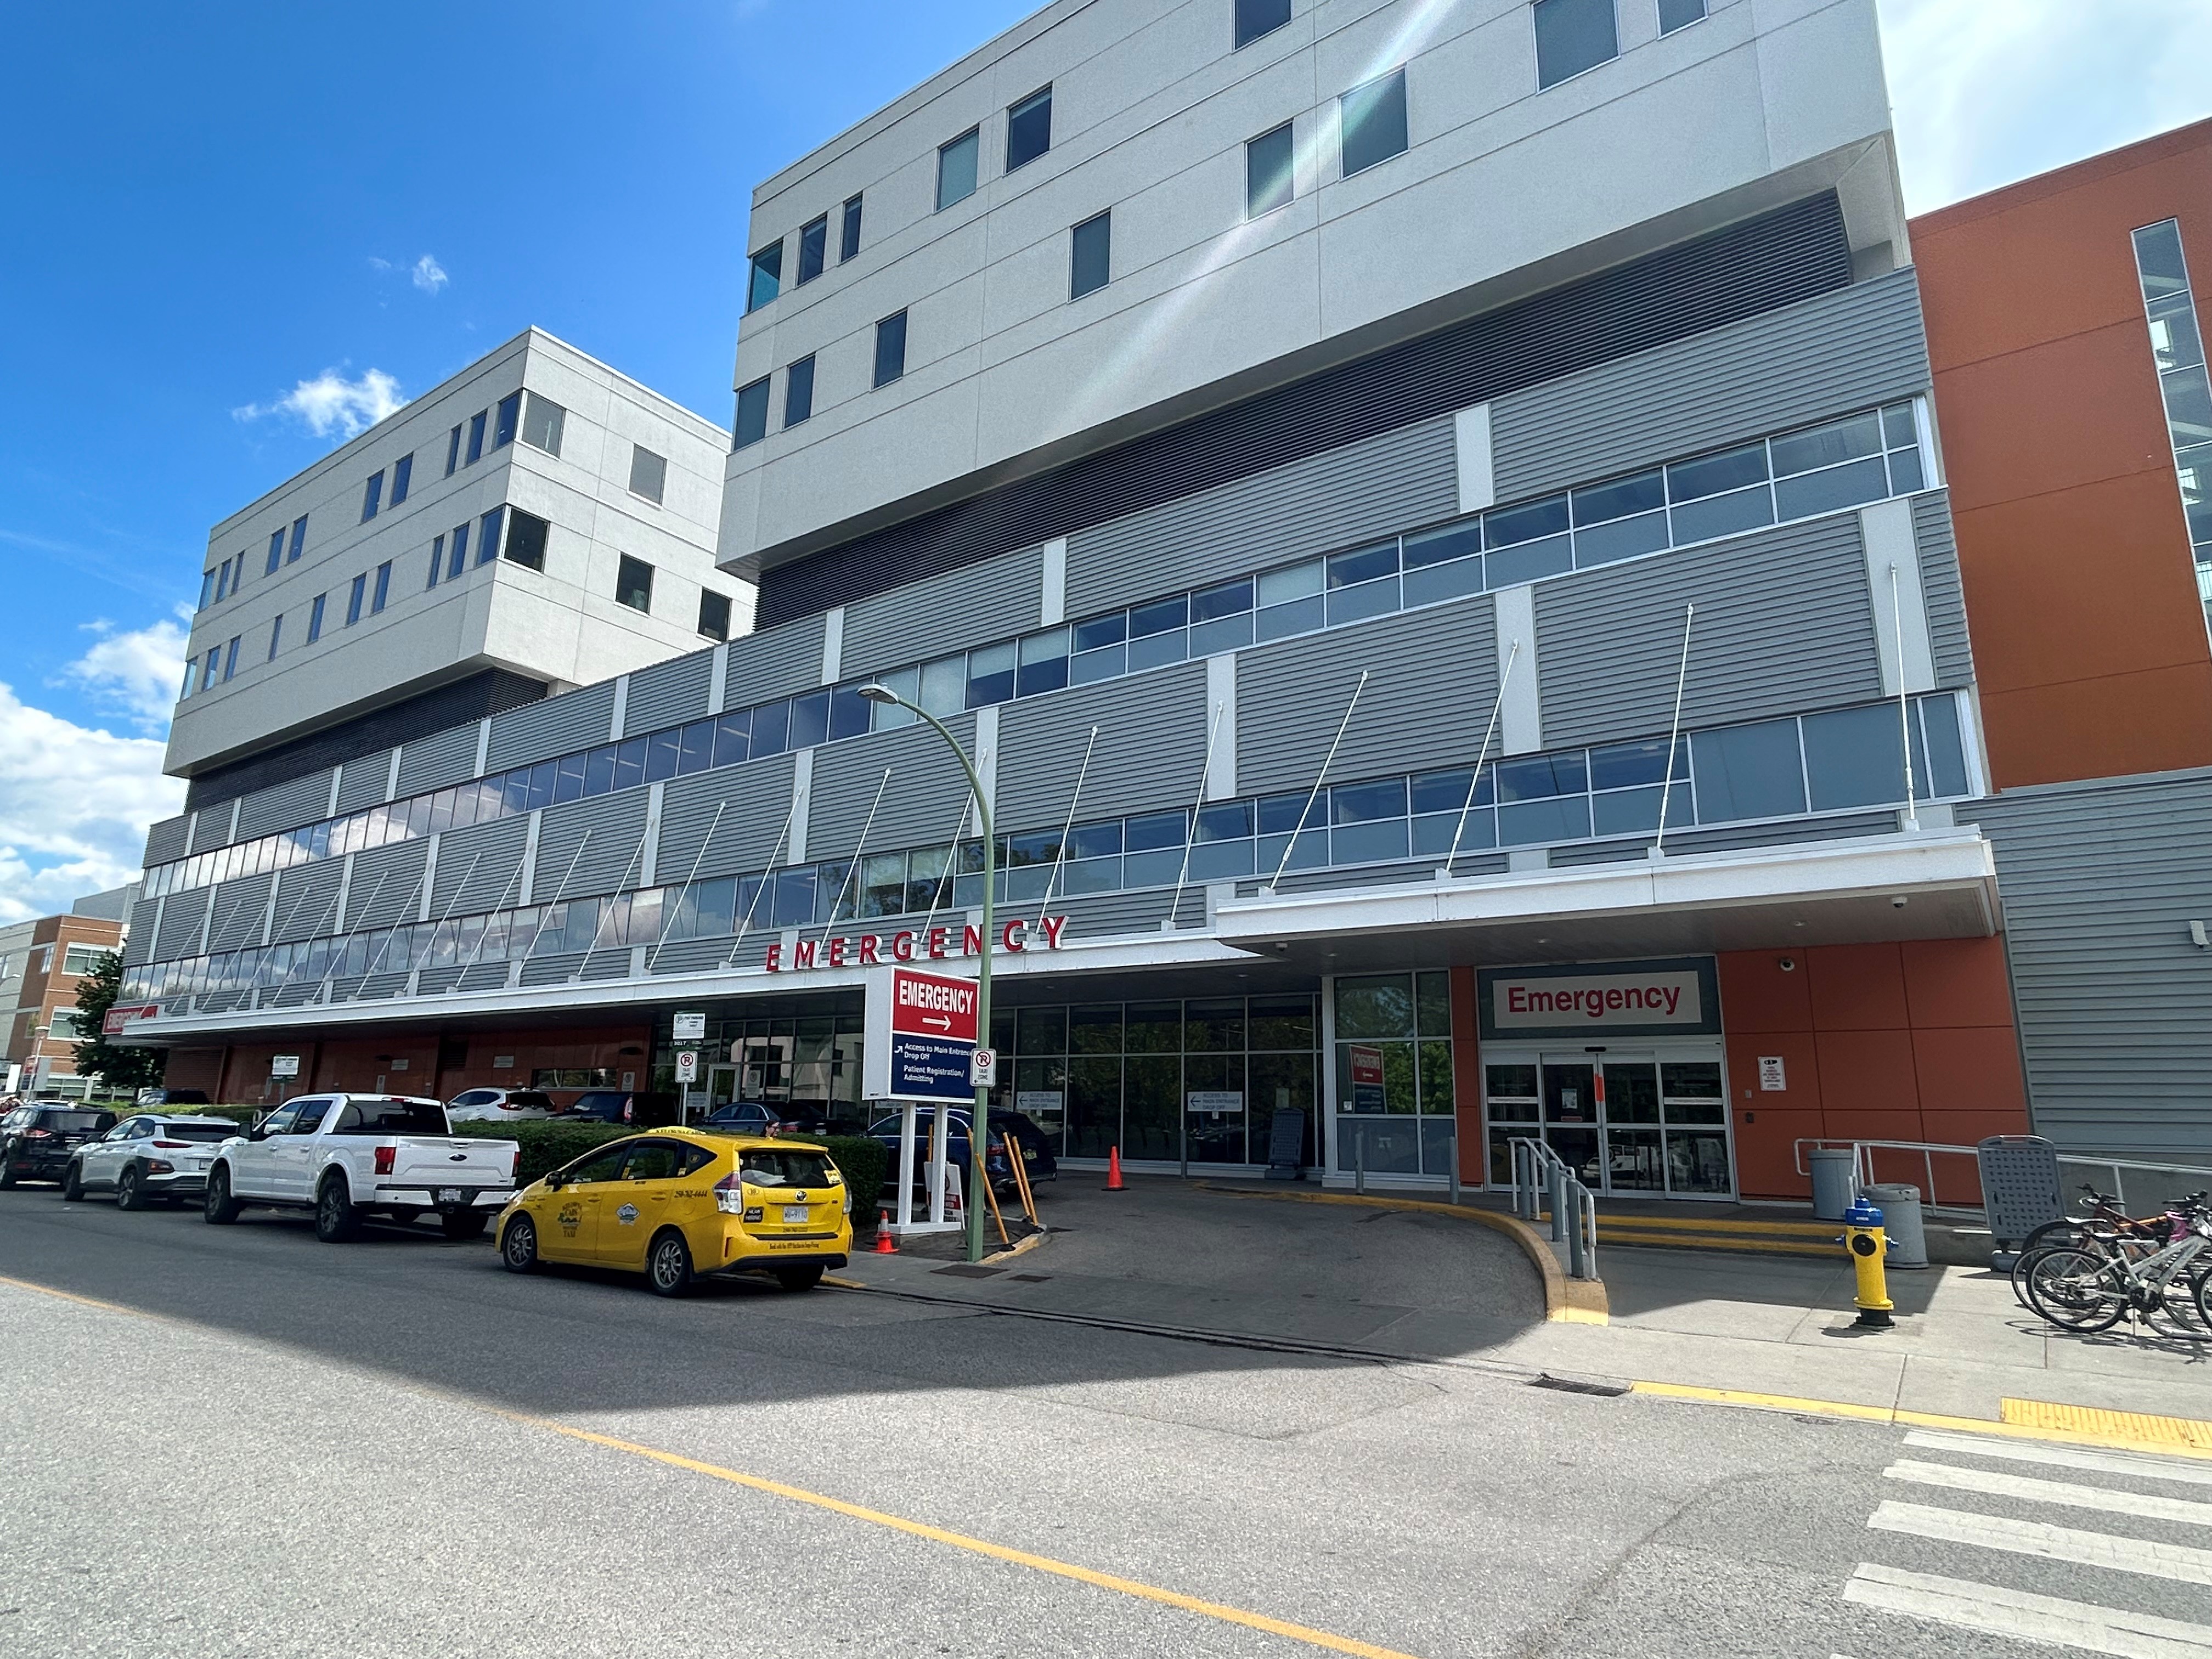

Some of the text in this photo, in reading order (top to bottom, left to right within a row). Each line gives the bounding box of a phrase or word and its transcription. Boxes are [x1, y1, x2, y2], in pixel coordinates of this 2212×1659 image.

[766, 916, 1070, 972] EMERGENCY
[899, 979, 973, 1015] EMERGENCY
[1508, 986, 1681, 1017] Emergency
[904, 1042, 926, 1052] Access
[949, 1047, 972, 1056] Entranc
[904, 1051, 919, 1061] Drop
[904, 1064, 964, 1077] Patient Registration/
[904, 1073, 934, 1084] Admitting
